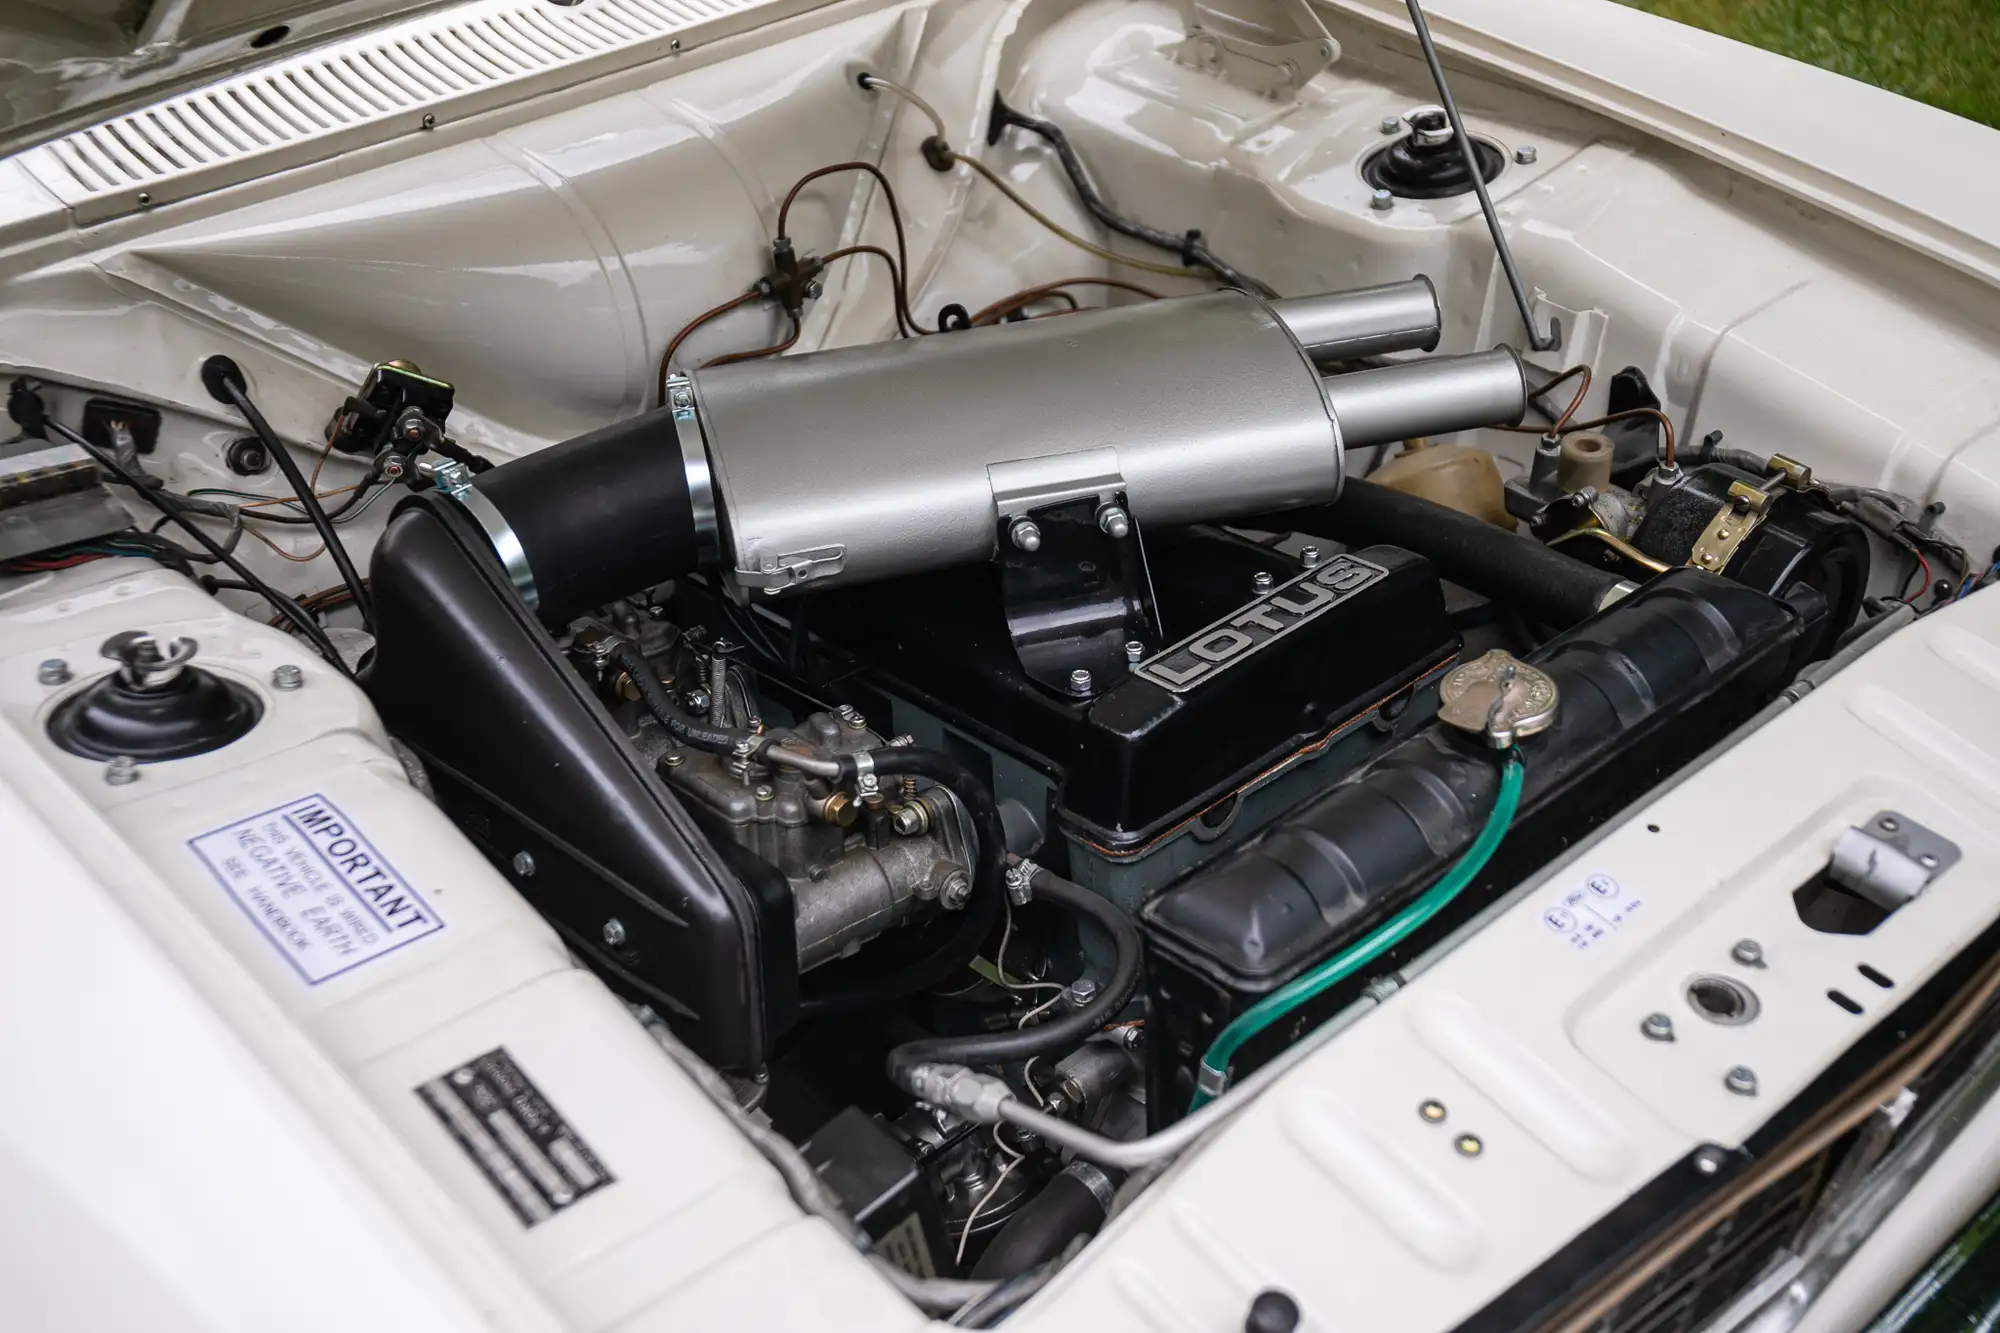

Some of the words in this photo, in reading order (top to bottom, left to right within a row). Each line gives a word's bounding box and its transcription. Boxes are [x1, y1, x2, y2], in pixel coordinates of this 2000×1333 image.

[1149, 561, 1373, 686] LOTUS
[233, 827, 308, 899] NEGATIVE
[299, 905, 360, 956] EARTH
[291, 803, 429, 929] IMPORTANT
